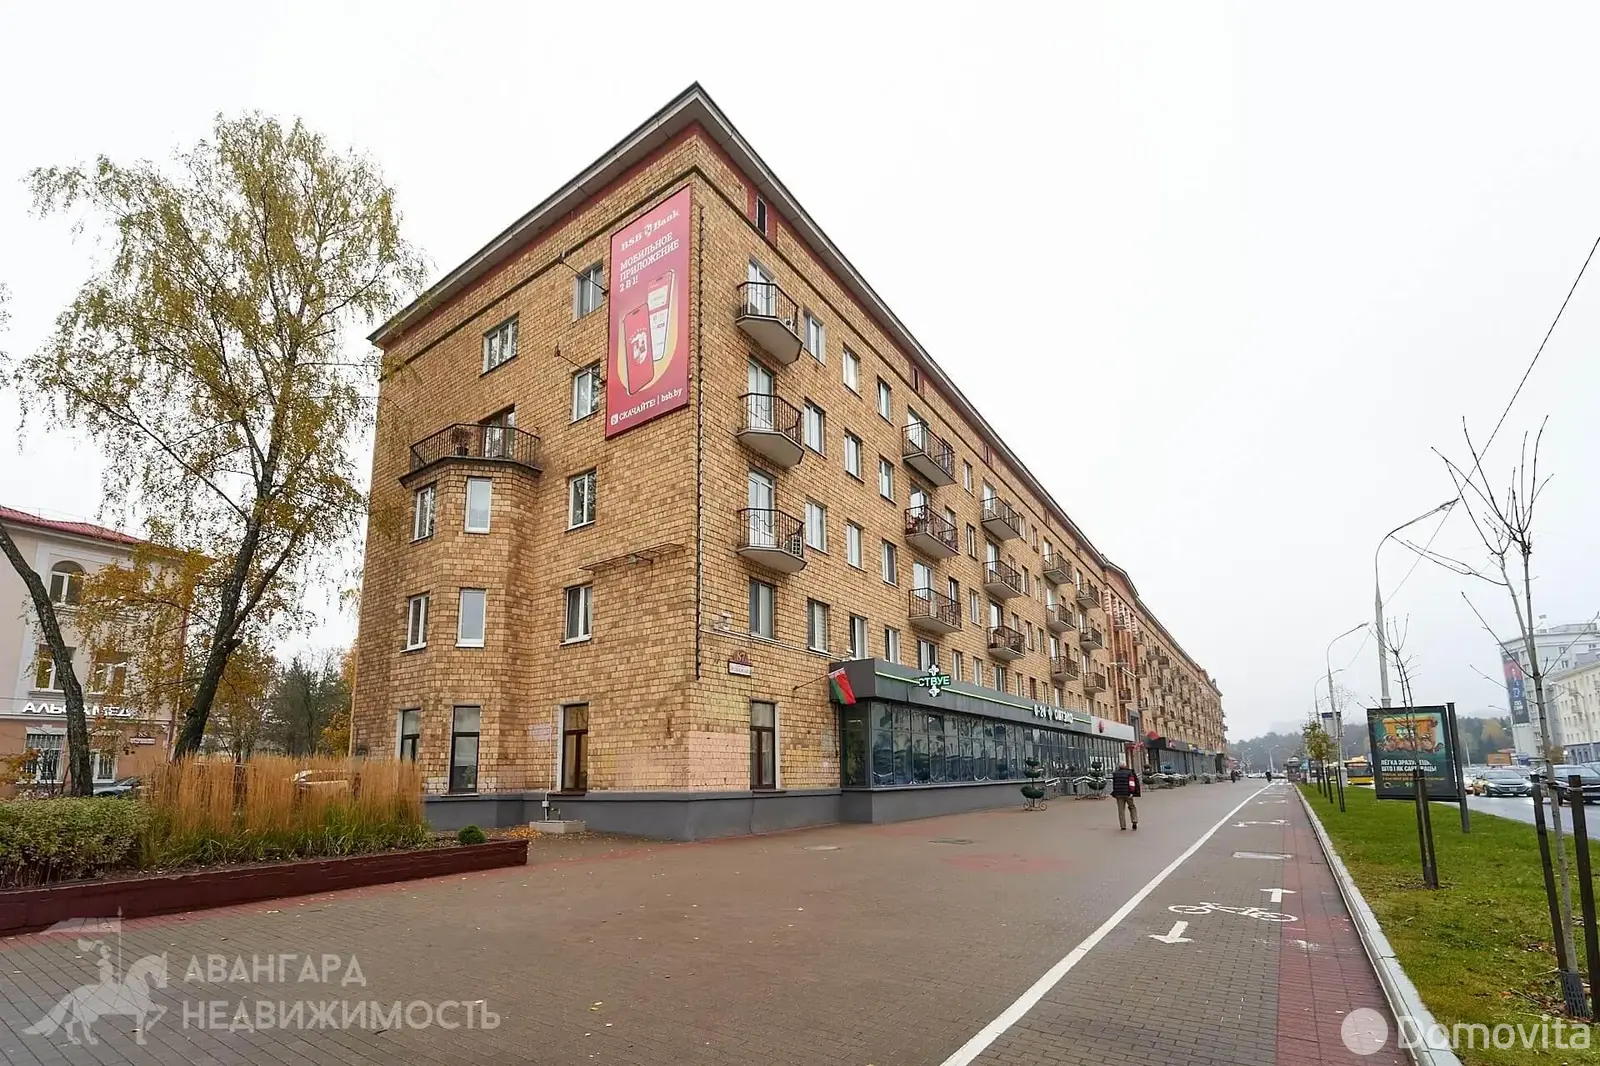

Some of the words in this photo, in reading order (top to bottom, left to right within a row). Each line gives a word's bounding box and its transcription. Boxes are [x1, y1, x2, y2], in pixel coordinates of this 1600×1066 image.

[652, 209, 680, 232] Bank
[620, 232, 674, 271] МОБИЛЬНОЕ
[620, 239, 680, 282] ПРИЛОЖЕНИЕ
[620, 283, 626, 293] 2
[626, 278, 632, 289] В
[661, 387, 683, 402] bsb.by
[619, 398, 656, 421] СКАЧАЙТЕ!
[918, 675, 950, 687] СТВУЕ
